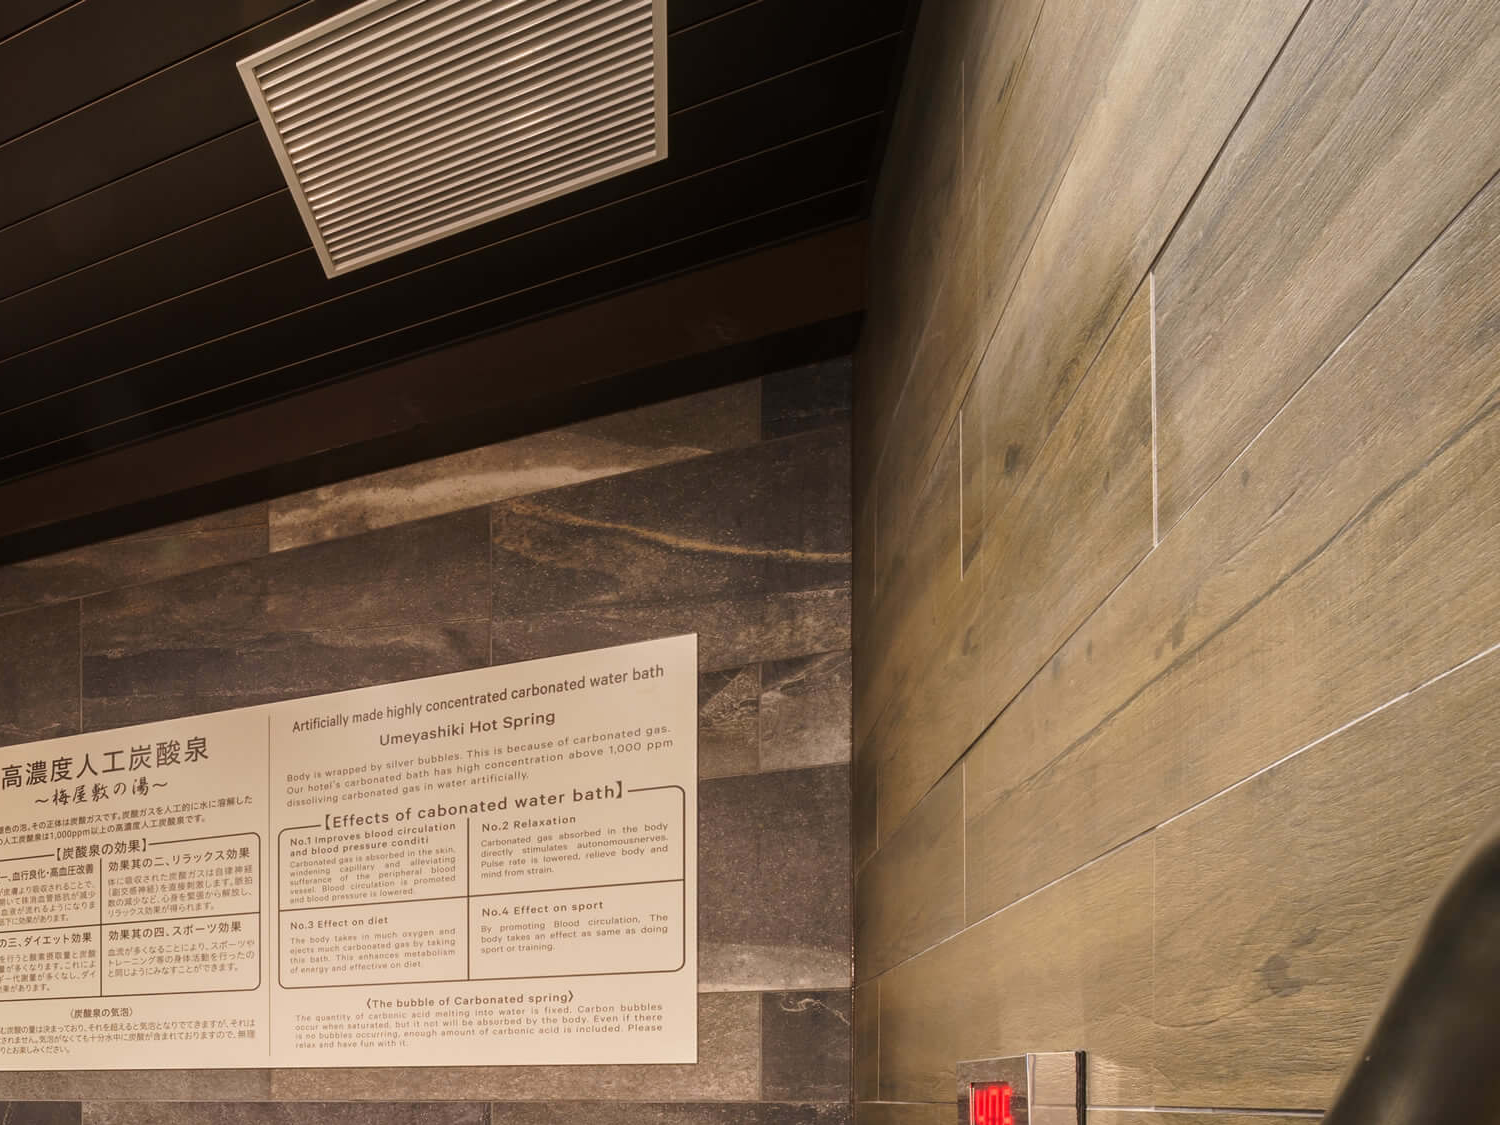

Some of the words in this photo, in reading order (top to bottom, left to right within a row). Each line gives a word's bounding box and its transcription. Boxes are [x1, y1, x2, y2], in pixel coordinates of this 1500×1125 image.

[292, 713, 348, 733] Artificially
[352, 708, 383, 723] made
[386, 701, 422, 719] highly
[425, 687, 507, 712] concentrated
[510, 675, 585, 699] carbonated
[589, 672, 628, 687] water
[632, 663, 663, 680] bath
[379, 722, 464, 746] Umeyashiki
[469, 719, 497, 733] Hot
[502, 712, 555, 731] Spring
[286, 771, 310, 782] Body
[313, 771, 321, 779] is
[324, 763, 367, 777] wrapped
[370, 762, 382, 772] by
[385, 759, 413, 769] silver
[466, 748, 489, 758] This
[493, 746, 502, 755] is
[506, 740, 553, 753] because
[557, 736, 569, 747] of
[572, 727, 641, 744] carbonated
[645, 725, 670, 737] gas.
[1, 736, 209, 790] 高濃度人工炭酸泉
[286, 786, 303, 795] Our
[344, 772, 401, 787] carbonated
[405, 769, 429, 779] bath
[433, 767, 452, 776] has
[456, 762, 480, 774] high
[484, 753, 563, 770] concentration
[568, 748, 603, 759] above
[609, 741, 641, 755] 1,000
[646, 739, 673, 752] ppm
[341, 785, 398, 800] carbonated
[402, 785, 420, 795] gas
[423, 782, 433, 791] in
[437, 779, 466, 789] water
[395, 807, 411, 821] of
[417, 796, 507, 819] cabonated
[514, 793, 564, 808] water
[481, 820, 508, 832] No.2
[513, 815, 575, 829] Relaxation
[290, 836, 311, 847] No.1
[364, 827, 393, 839] blood
[397, 823, 455, 835] circulation
[480, 835, 531, 847] Carbonated
[536, 835, 552, 843] gas
[558, 828, 601, 840] absorbed
[607, 827, 616, 835] in
[622, 824, 638, 833] the
[644, 821, 668, 832] body
[56, 838, 147, 861] 【炭酸泉の効果】
[290, 847, 307, 857] and
[311, 844, 339, 855] blood
[342, 841, 387, 853] pressure
[418, 848, 433, 856] the
[480, 847, 513, 858] directly
[521, 844, 567, 854] stimulates
[480, 859, 504, 868] Pulse
[530, 855, 538, 864] is
[585, 850, 616, 859] relieve
[621, 846, 645, 856] body
[650, 844, 668, 853] and
[339, 863, 375, 873] capillary
[339, 874, 348, 882] of
[356, 872, 370, 880] the
[430, 863, 455, 874] blood
[480, 869, 502, 879] mind
[504, 868, 524, 877] from
[321, 882, 345, 893] Blood
[349, 880, 395, 890] circulation
[413, 872, 455, 885] promoted
[306, 893, 329, 903] blood
[481, 906, 508, 917] No.4
[513, 905, 548, 915] Effect
[553, 904, 567, 912] on
[571, 901, 603, 912] sport
[290, 920, 314, 930] No.3
[317, 919, 348, 928] Effect
[367, 916, 388, 925] diet
[480, 925, 492, 934] By
[499, 921, 545, 933] promoting
[553, 919, 579, 928] Blood
[649, 913, 668, 921] The
[309, 935, 330, 944] body
[374, 930, 397, 940] much
[438, 927, 455, 935] and
[412, 939, 423, 948] by
[427, 938, 456, 946] taking
[480, 935, 502, 944] body
[506, 933, 530, 942] takes
[549, 930, 576, 939] effect
[596, 928, 620, 936] same
[640, 925, 668, 934] doing
[404, 948, 455, 957] metabolism
[480, 945, 503, 954] sport
[396, 997, 434, 1007] bubble
[438, 996, 450, 1006] of
[453, 993, 523, 1005] Carbonated
[474, 1008, 493, 1016] into
[577, 1004, 614, 1013] Carbon
[620, 1002, 662, 1012] bubbles
[442, 1018, 458, 1026] will
[541, 1015, 557, 1024] the
[593, 1014, 618, 1023] Even
